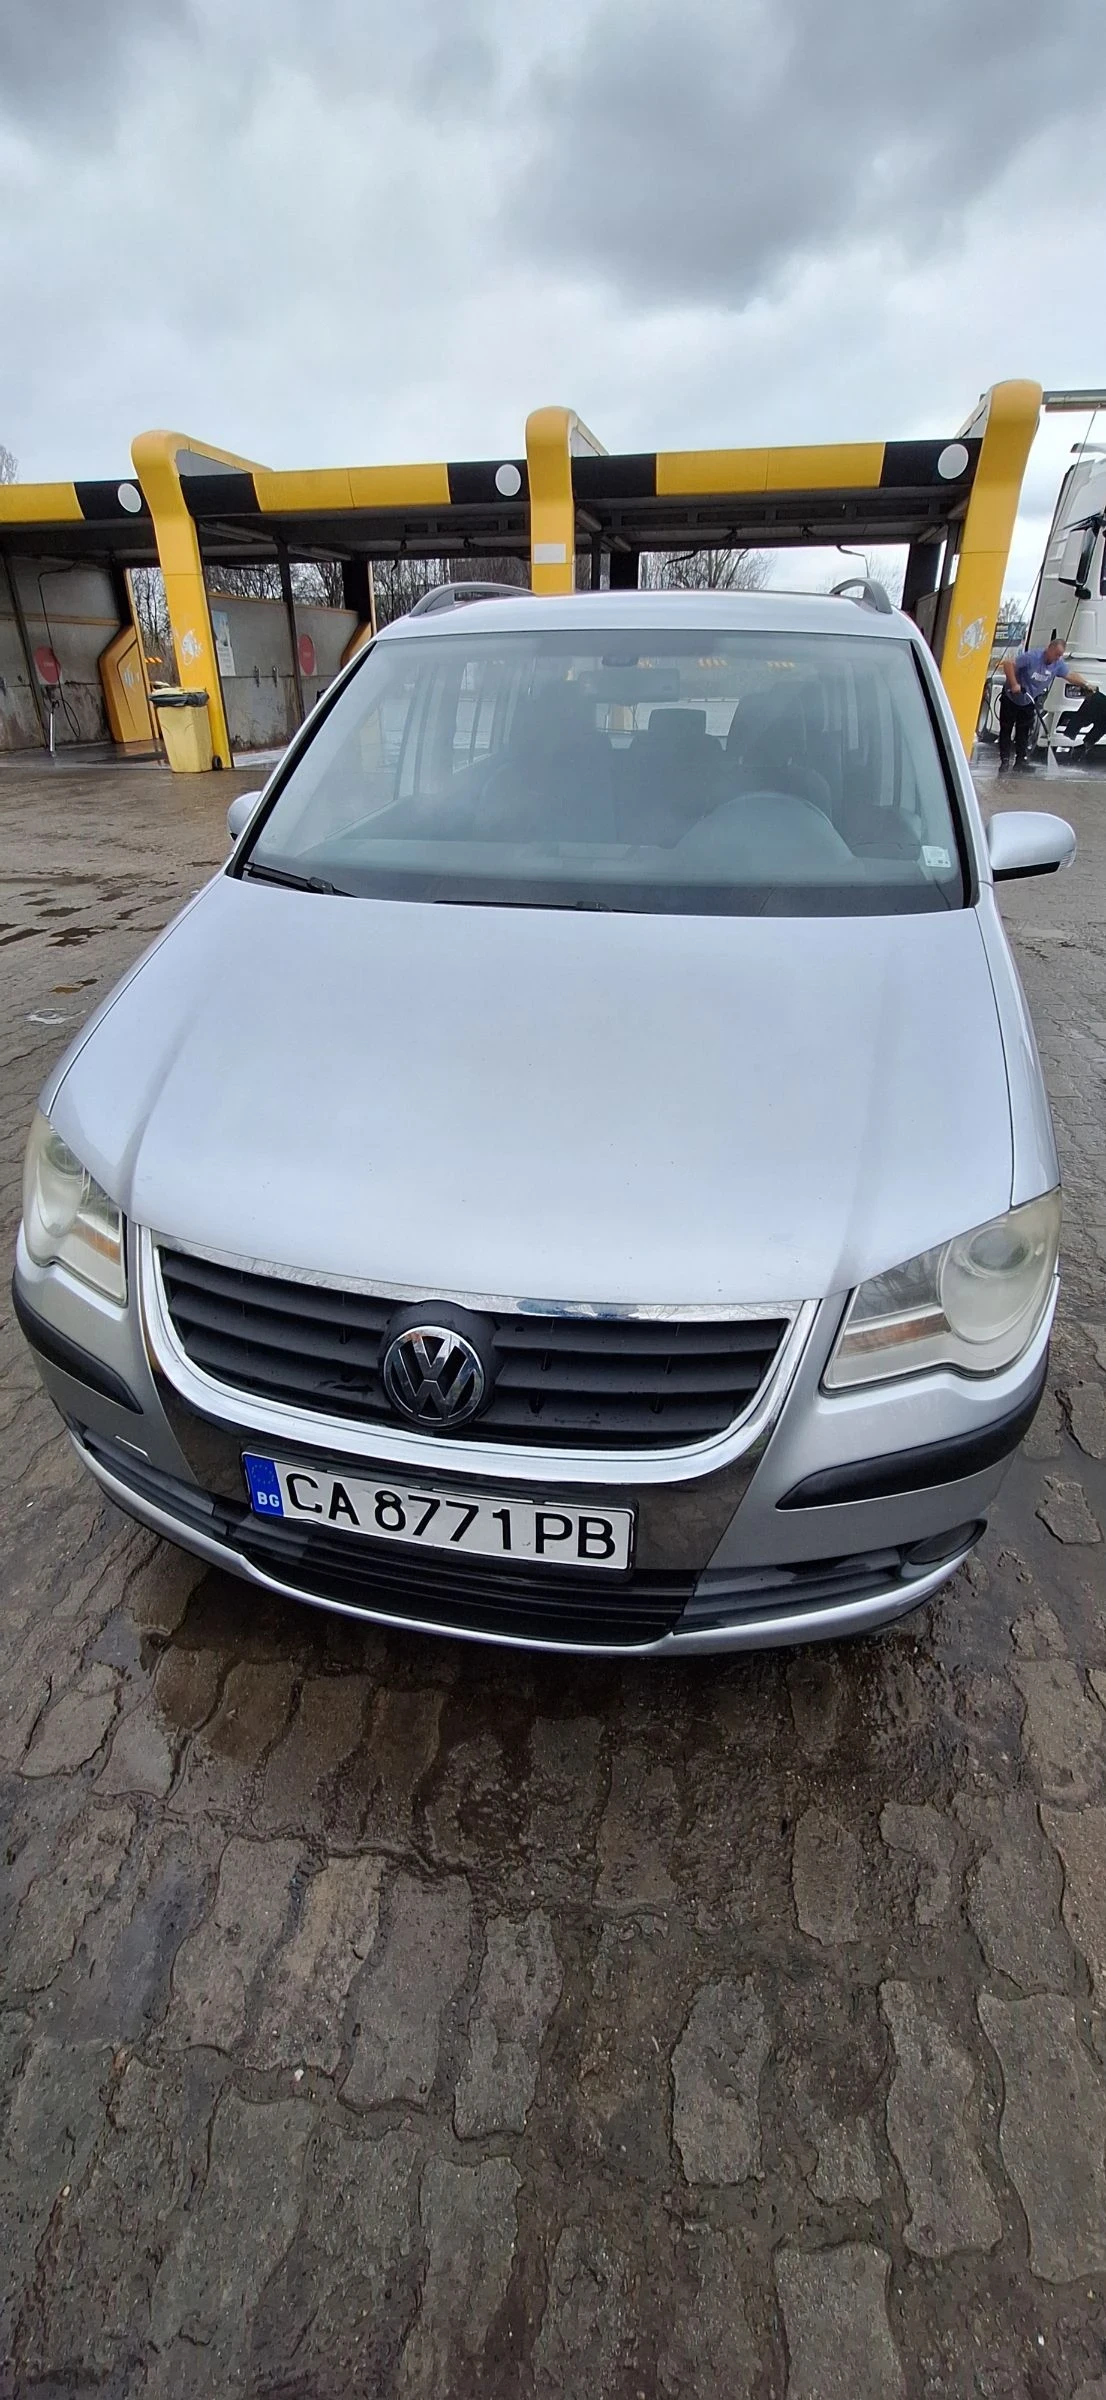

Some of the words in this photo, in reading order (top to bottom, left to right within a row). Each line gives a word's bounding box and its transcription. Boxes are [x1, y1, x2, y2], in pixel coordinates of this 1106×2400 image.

[386, 1328, 482, 1421] VW
[257, 1492, 280, 1508] BG
[285, 1473, 361, 1526] CA
[374, 1490, 512, 1551] 8771
[534, 1511, 616, 1560] PB
